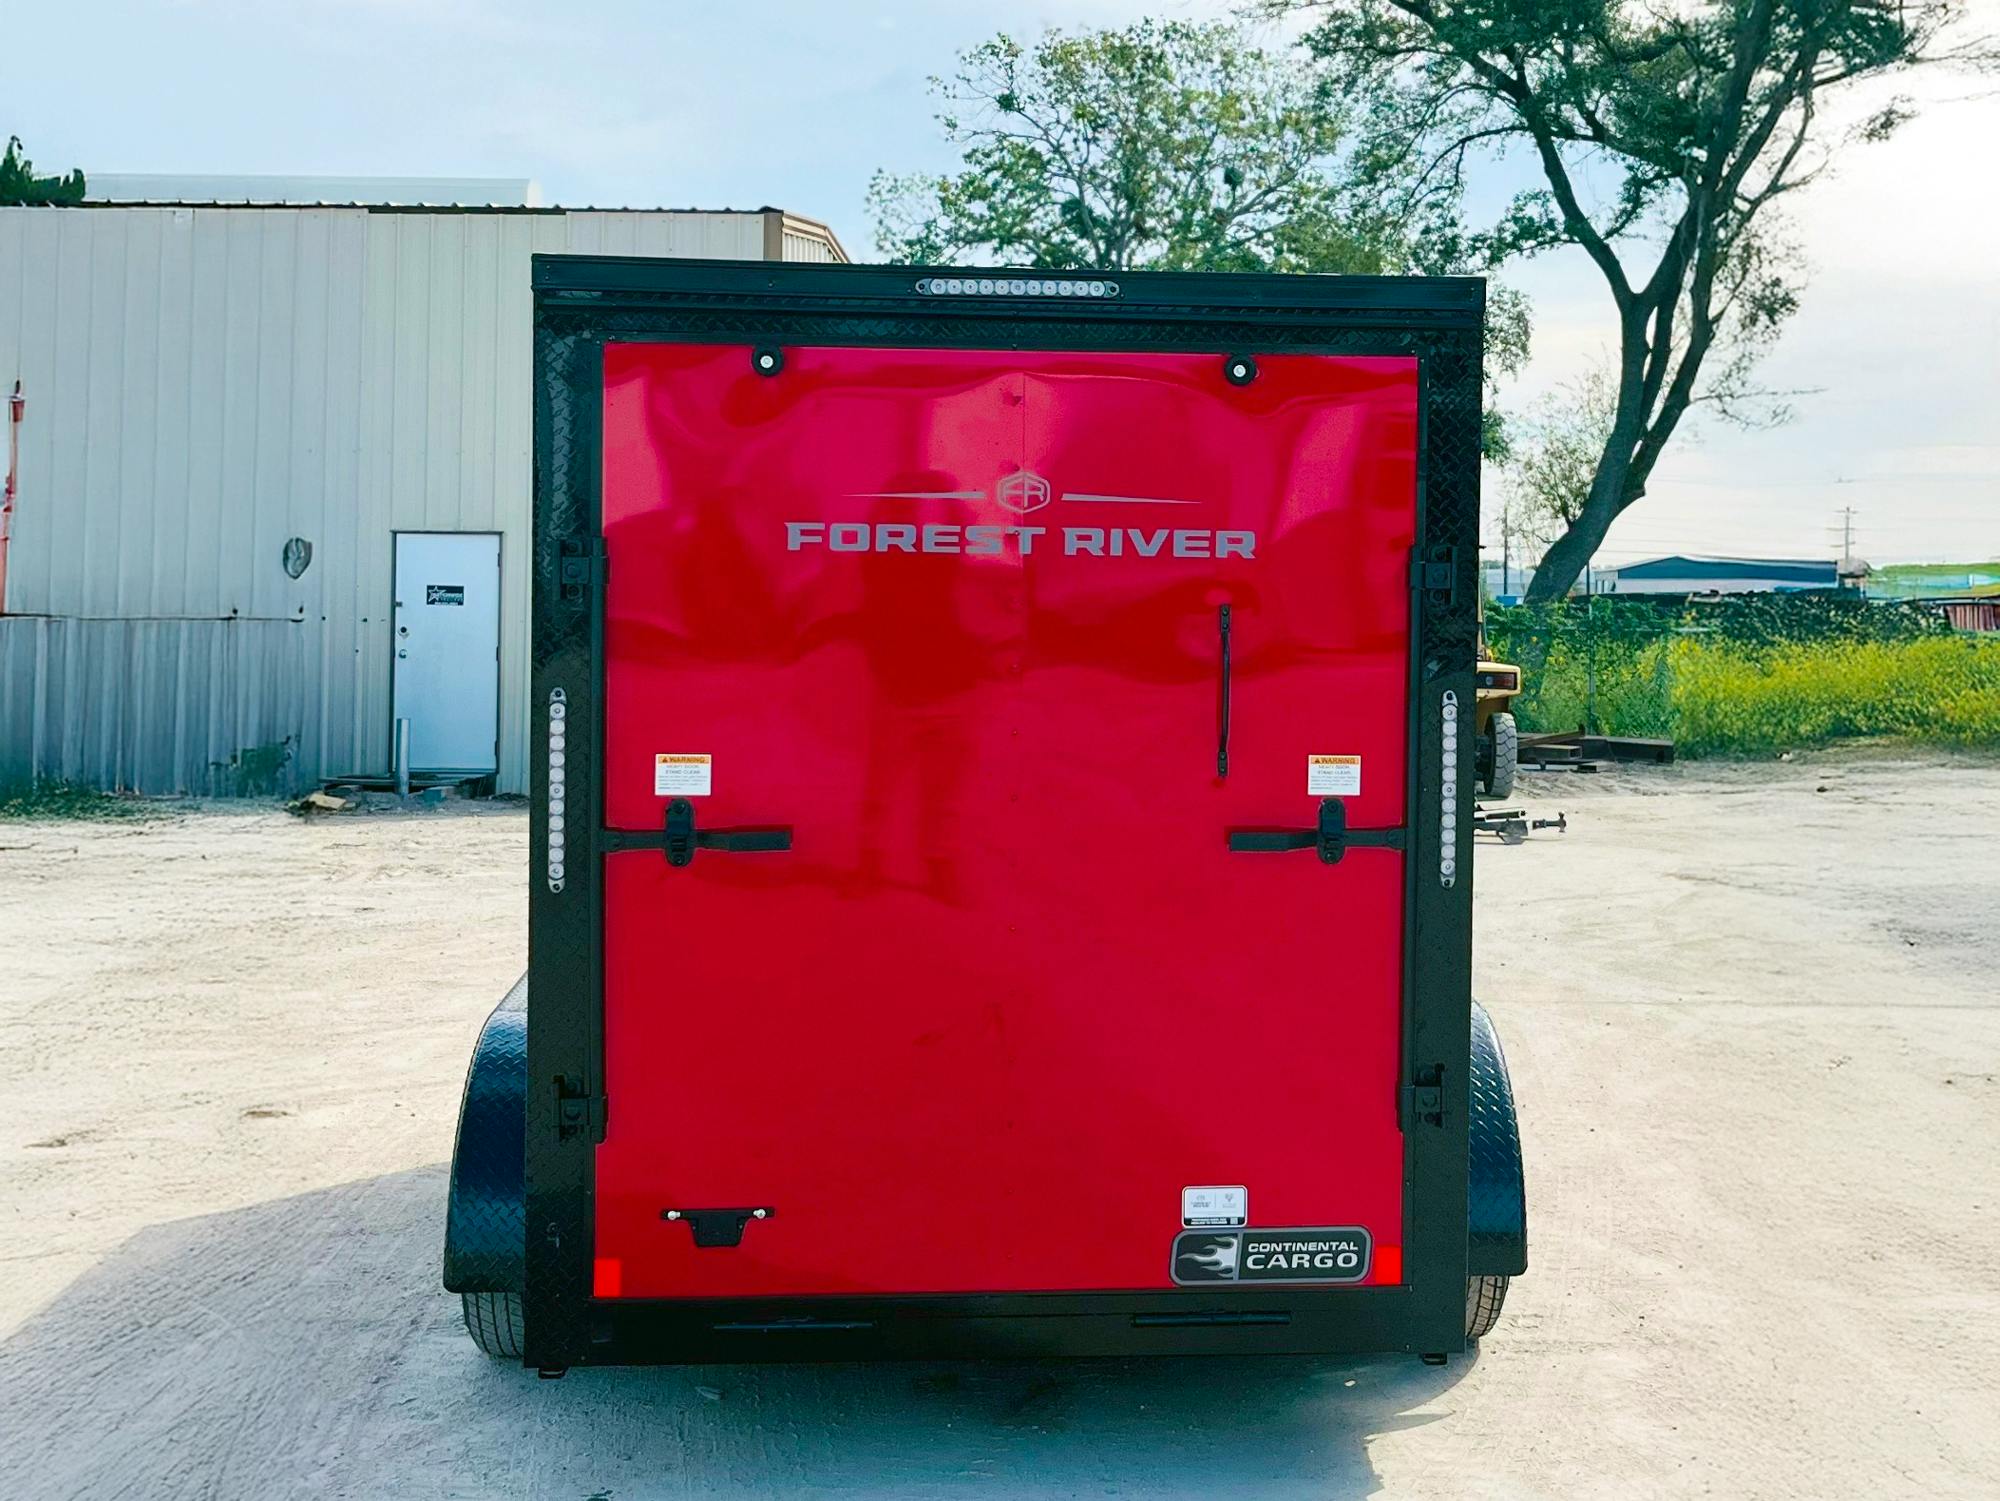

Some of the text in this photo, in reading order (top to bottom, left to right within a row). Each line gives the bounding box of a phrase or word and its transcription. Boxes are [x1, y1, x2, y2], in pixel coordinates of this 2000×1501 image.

[784, 521, 1256, 559] FOREST RIVER
[669, 756, 705, 764] WARNING
[1247, 1240, 1359, 1253] CONTINENTAL
[1246, 1252, 1359, 1270] CARGO
